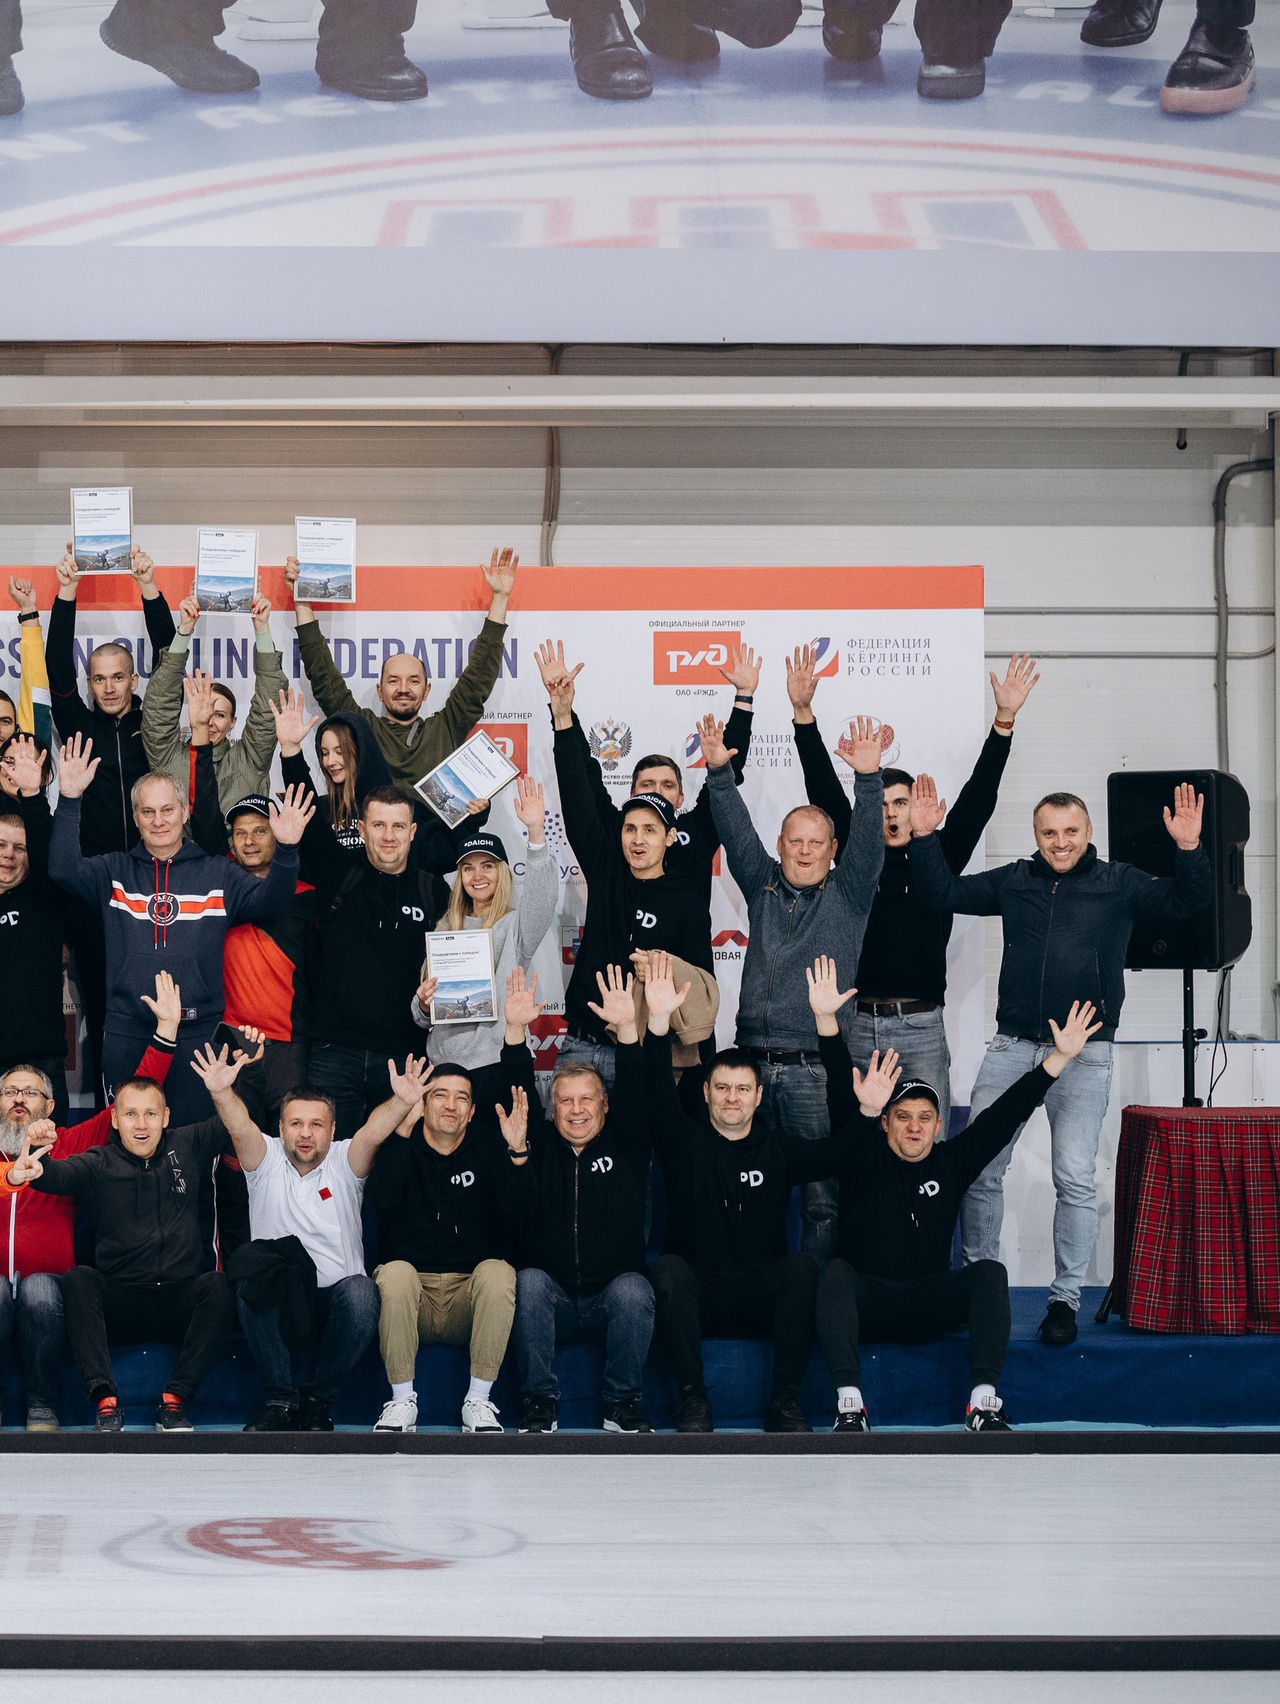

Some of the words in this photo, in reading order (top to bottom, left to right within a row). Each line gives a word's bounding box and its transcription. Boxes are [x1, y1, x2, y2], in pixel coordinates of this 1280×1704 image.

[649, 619, 709, 628] ОФИЦИАЛЬНЫЙ
[847, 638, 930, 650] ФЕДЕРАЦИЯ
[848, 650, 931, 663] КЁРЛИНГА
[848, 666, 931, 676] РОССИИ
[751, 734, 792, 744] РАЦИЯ
[745, 758, 792, 767] ССИИ
